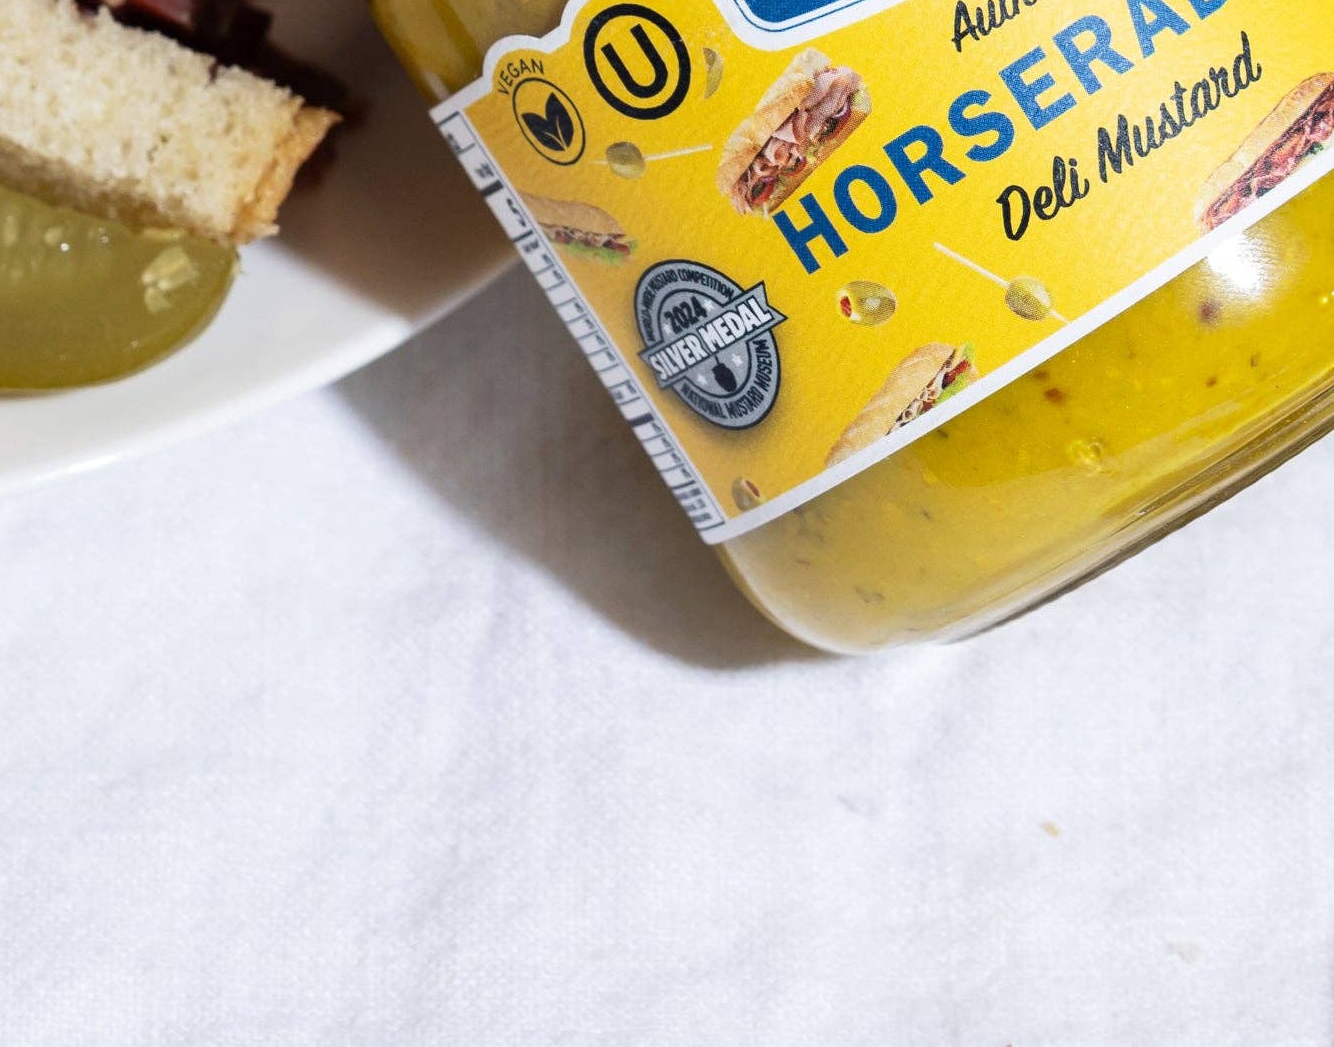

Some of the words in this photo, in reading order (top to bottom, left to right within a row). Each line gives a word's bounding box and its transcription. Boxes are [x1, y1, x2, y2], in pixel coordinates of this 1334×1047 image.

[498, 58, 545, 96] VEGAN
[995, 156, 1090, 242] Deli
[1096, 30, 1262, 184] Mustard
[647, 268, 678, 293] MUSTARD
[677, 268, 735, 300] COMPETITION
[650, 334, 709, 380] SILVER
[697, 296, 773, 355] MEDAL
[663, 295, 708, 335] 2024
[681, 383, 727, 419] NATIONAL
[726, 385, 765, 420] MUSTARD
[754, 339, 773, 391] MUSEUM
